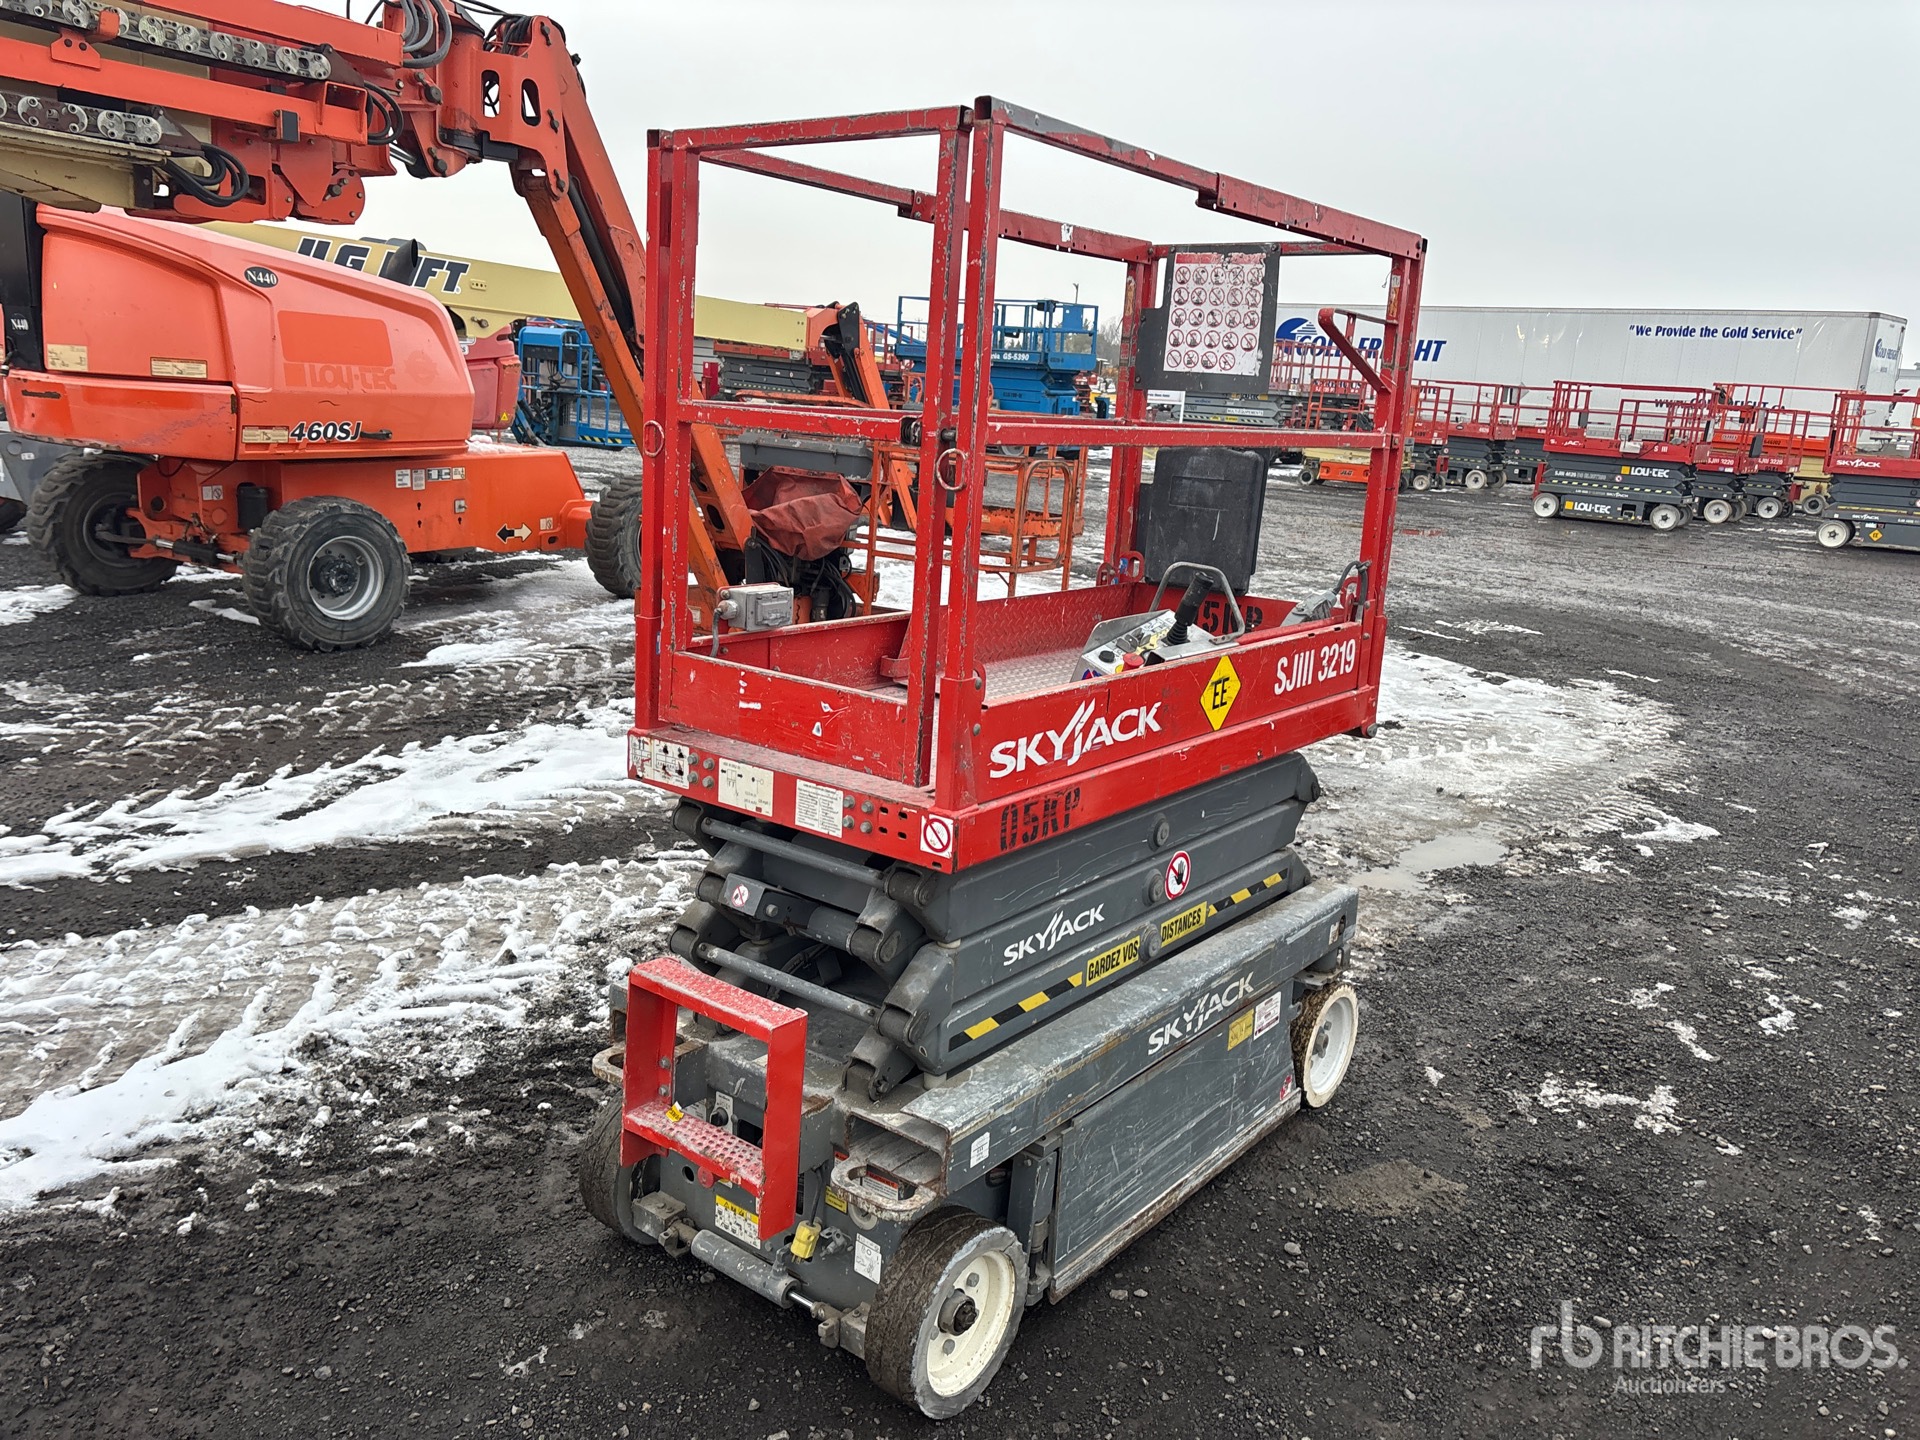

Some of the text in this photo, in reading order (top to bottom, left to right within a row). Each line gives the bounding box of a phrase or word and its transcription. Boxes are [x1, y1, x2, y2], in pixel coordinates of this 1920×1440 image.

[246, 269, 277, 285] N440
[1655, 326, 1696, 338] Provide
[1700, 326, 1718, 338] the
[1722, 326, 1748, 339] Gold
[290, 421, 363, 442] 460SJ
[1836, 458, 1881, 469] SKYJACK
[1317, 638, 1356, 683] 3219
[1211, 676, 1230, 711] EE
[989, 697, 1163, 779] SKYJACK
[1003, 903, 1105, 966] SKYJACK
[1088, 905, 1202, 982] GARDEZ VOS DISTANCES
[1148, 971, 1255, 1056] SKYJACK
